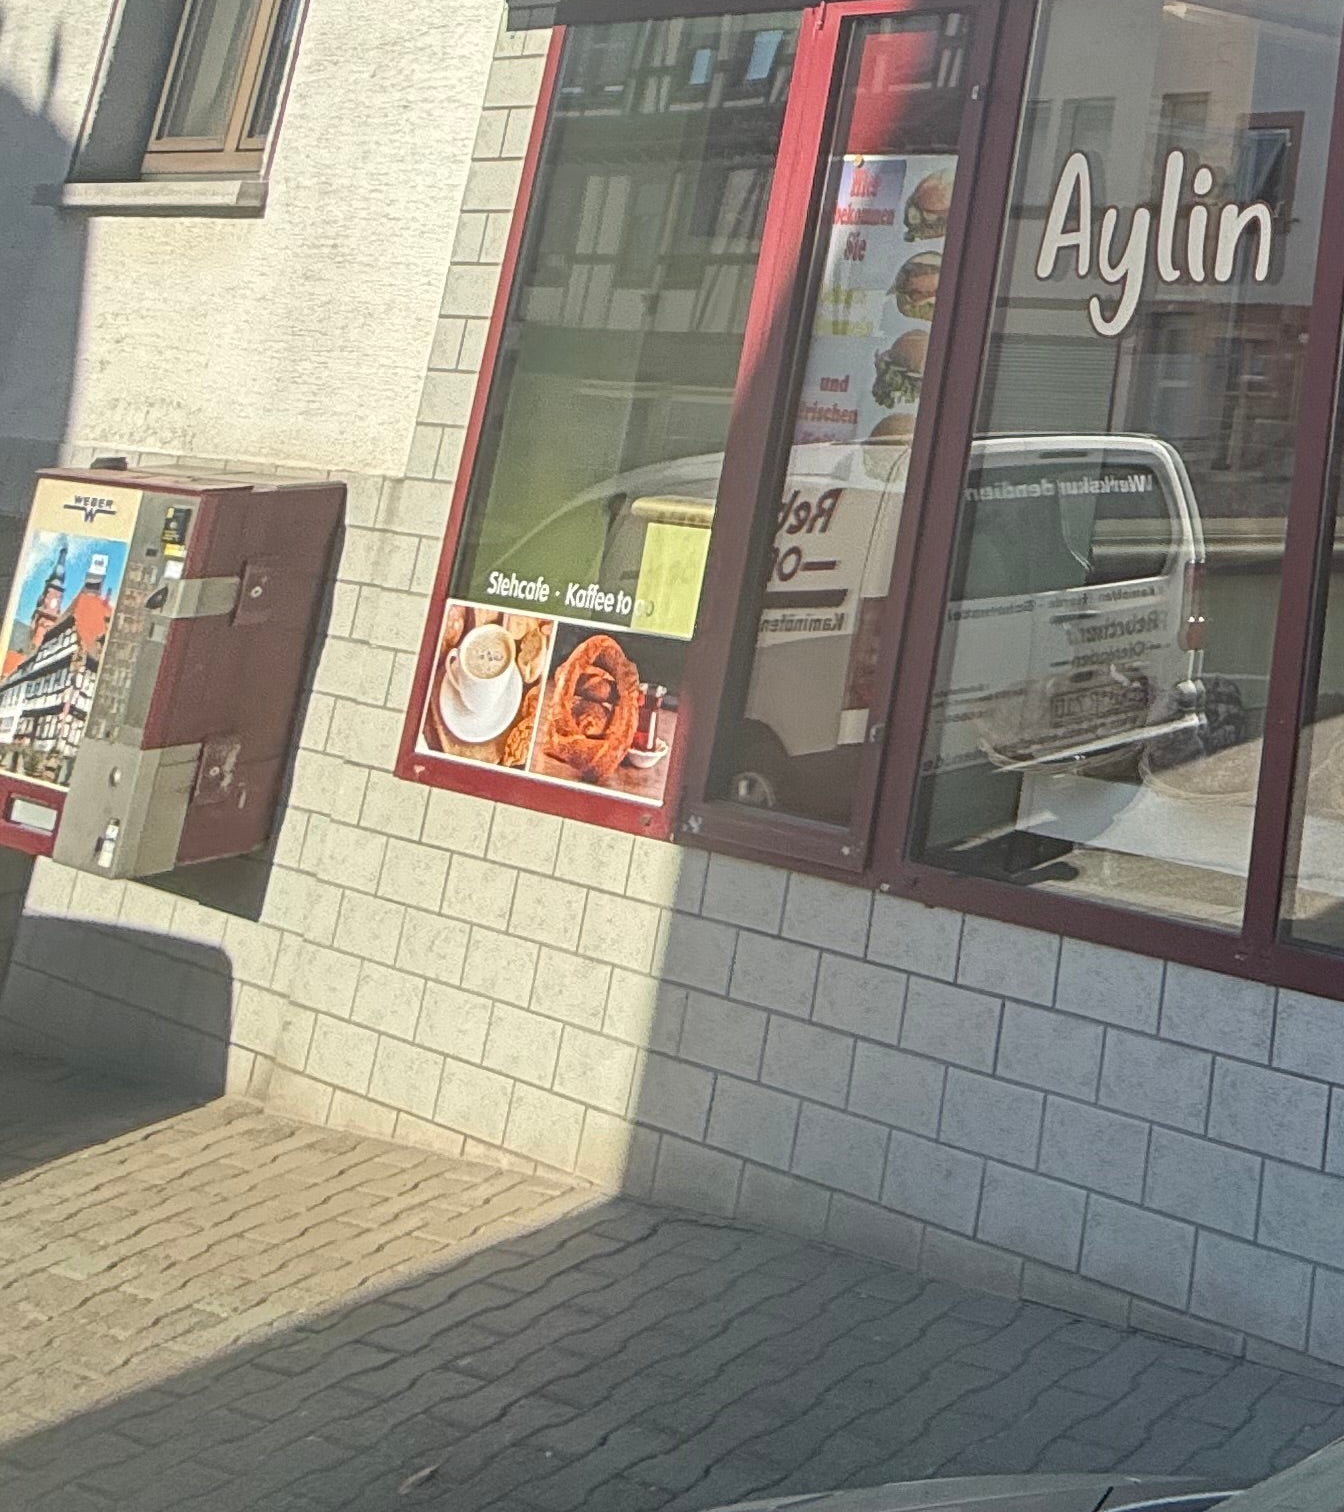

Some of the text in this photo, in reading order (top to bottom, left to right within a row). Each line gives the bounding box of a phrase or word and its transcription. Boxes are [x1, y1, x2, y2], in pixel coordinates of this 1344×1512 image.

[844, 231, 867, 261] Sie
[1036, 150, 1273, 337] Aylin
[820, 374, 850, 393] und
[75, 495, 113, 509] WEBER
[487, 571, 550, 603] Stehcafe
[565, 583, 614, 614] Kaffee
[614, 592, 632, 617] to
